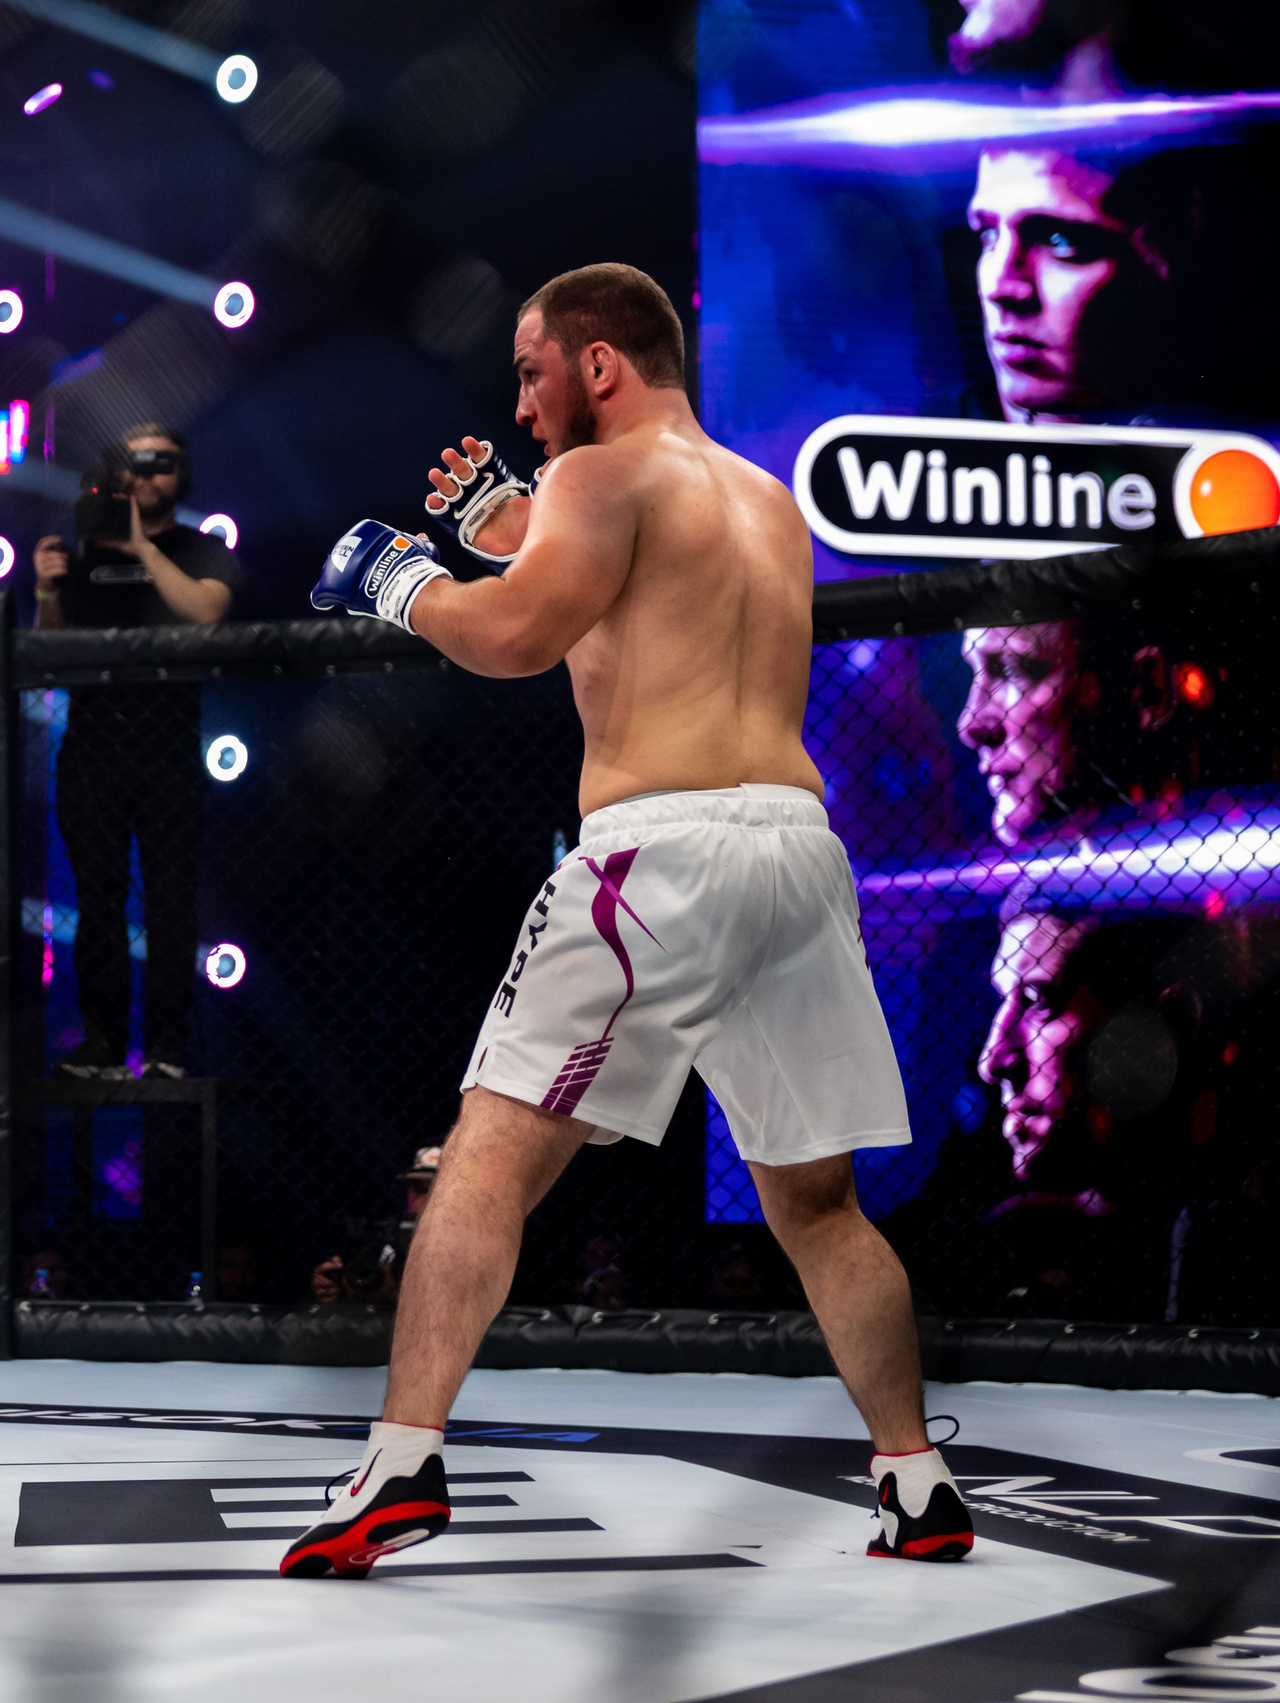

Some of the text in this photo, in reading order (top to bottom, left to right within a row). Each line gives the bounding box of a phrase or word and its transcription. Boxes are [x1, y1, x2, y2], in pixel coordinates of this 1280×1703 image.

[837, 447, 1156, 531] Winline
[369, 550, 399, 592] Winline
[494, 880, 557, 1018] HYPE
